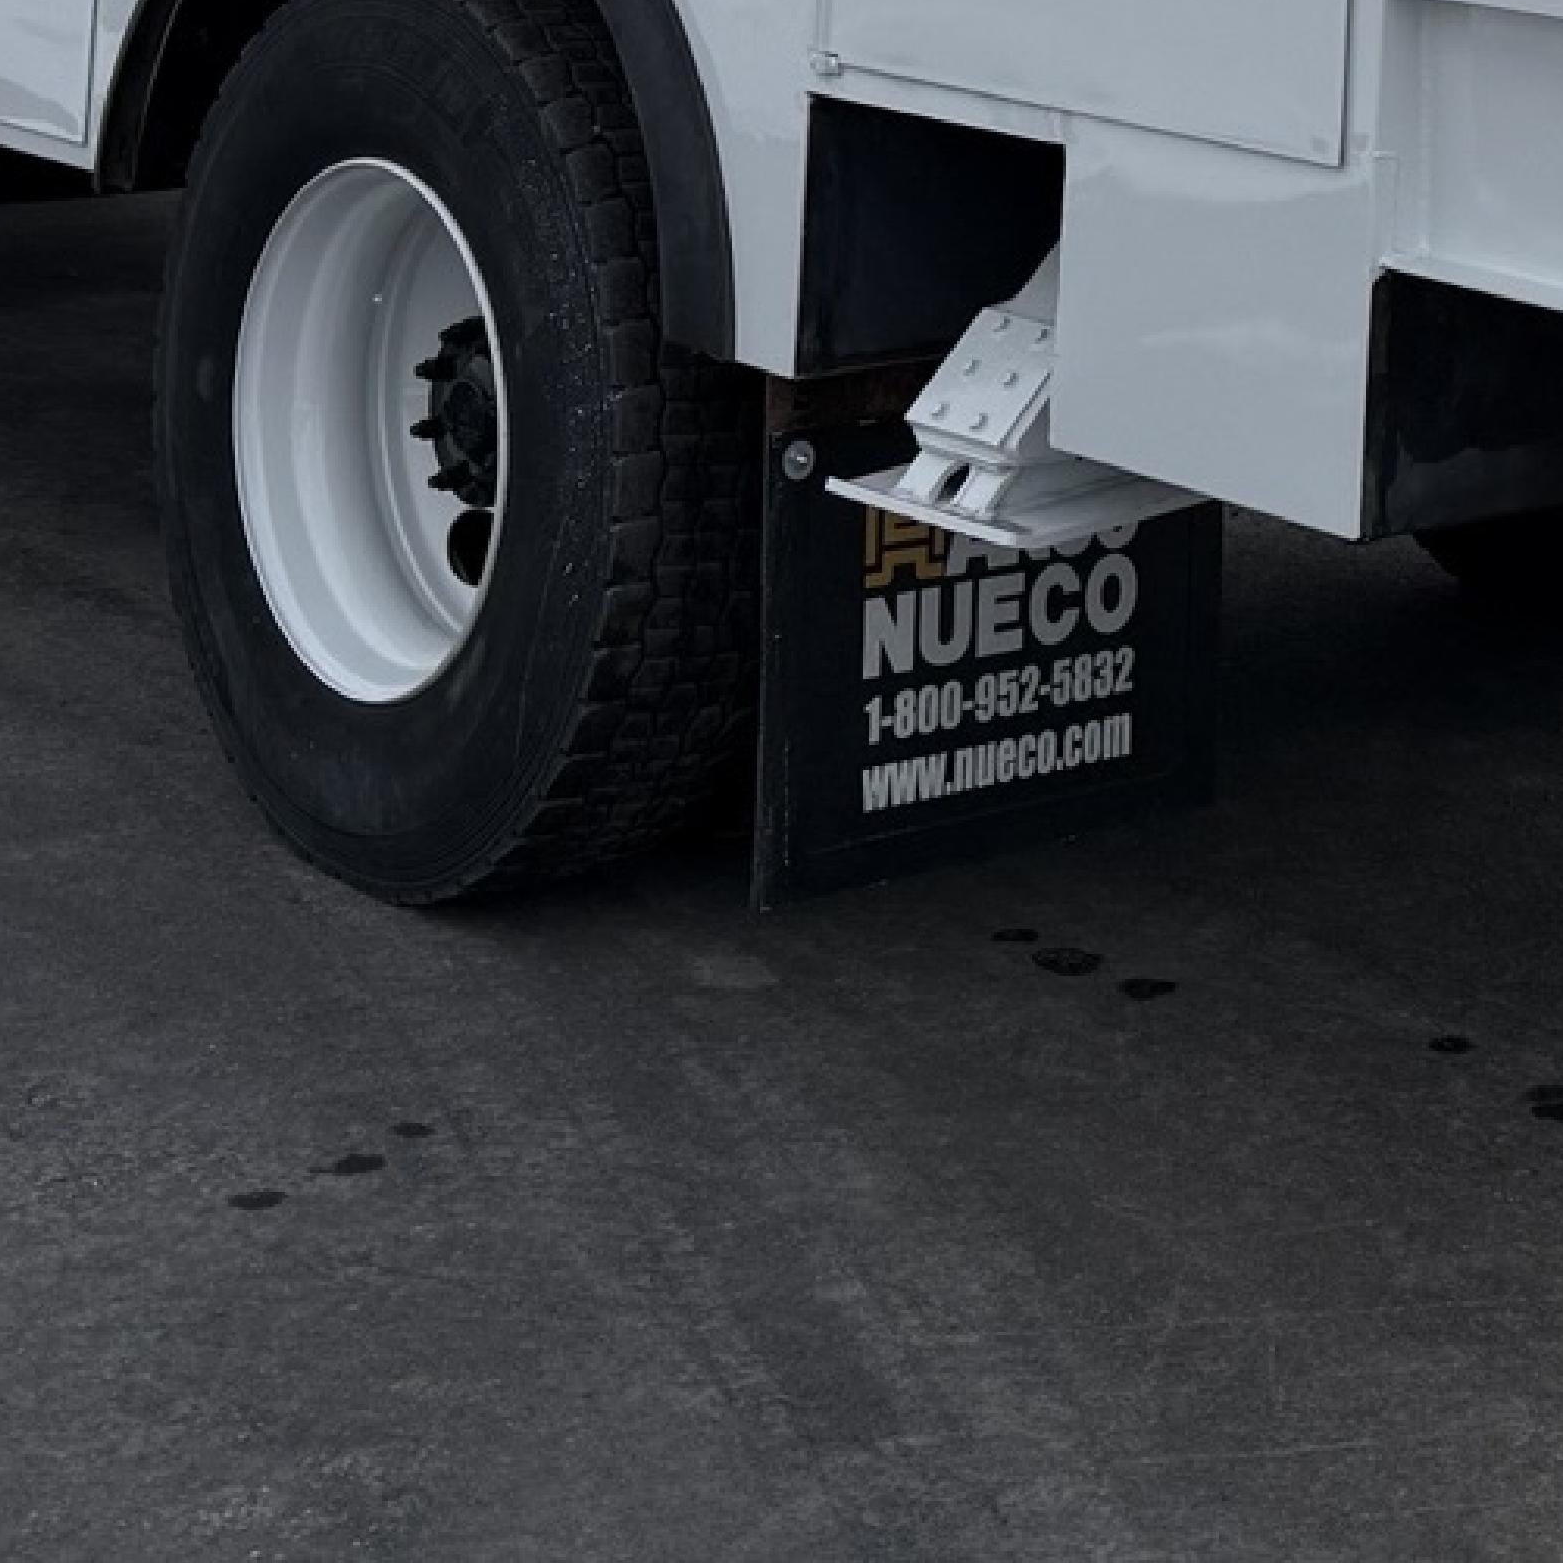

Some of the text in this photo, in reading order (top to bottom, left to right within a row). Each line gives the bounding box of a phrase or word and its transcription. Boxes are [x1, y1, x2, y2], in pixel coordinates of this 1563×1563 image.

[862, 553, 1138, 679] NUECO
[863, 645, 1136, 746] 1-800-952-5832
[862, 712, 1132, 814] www.nueco.com
